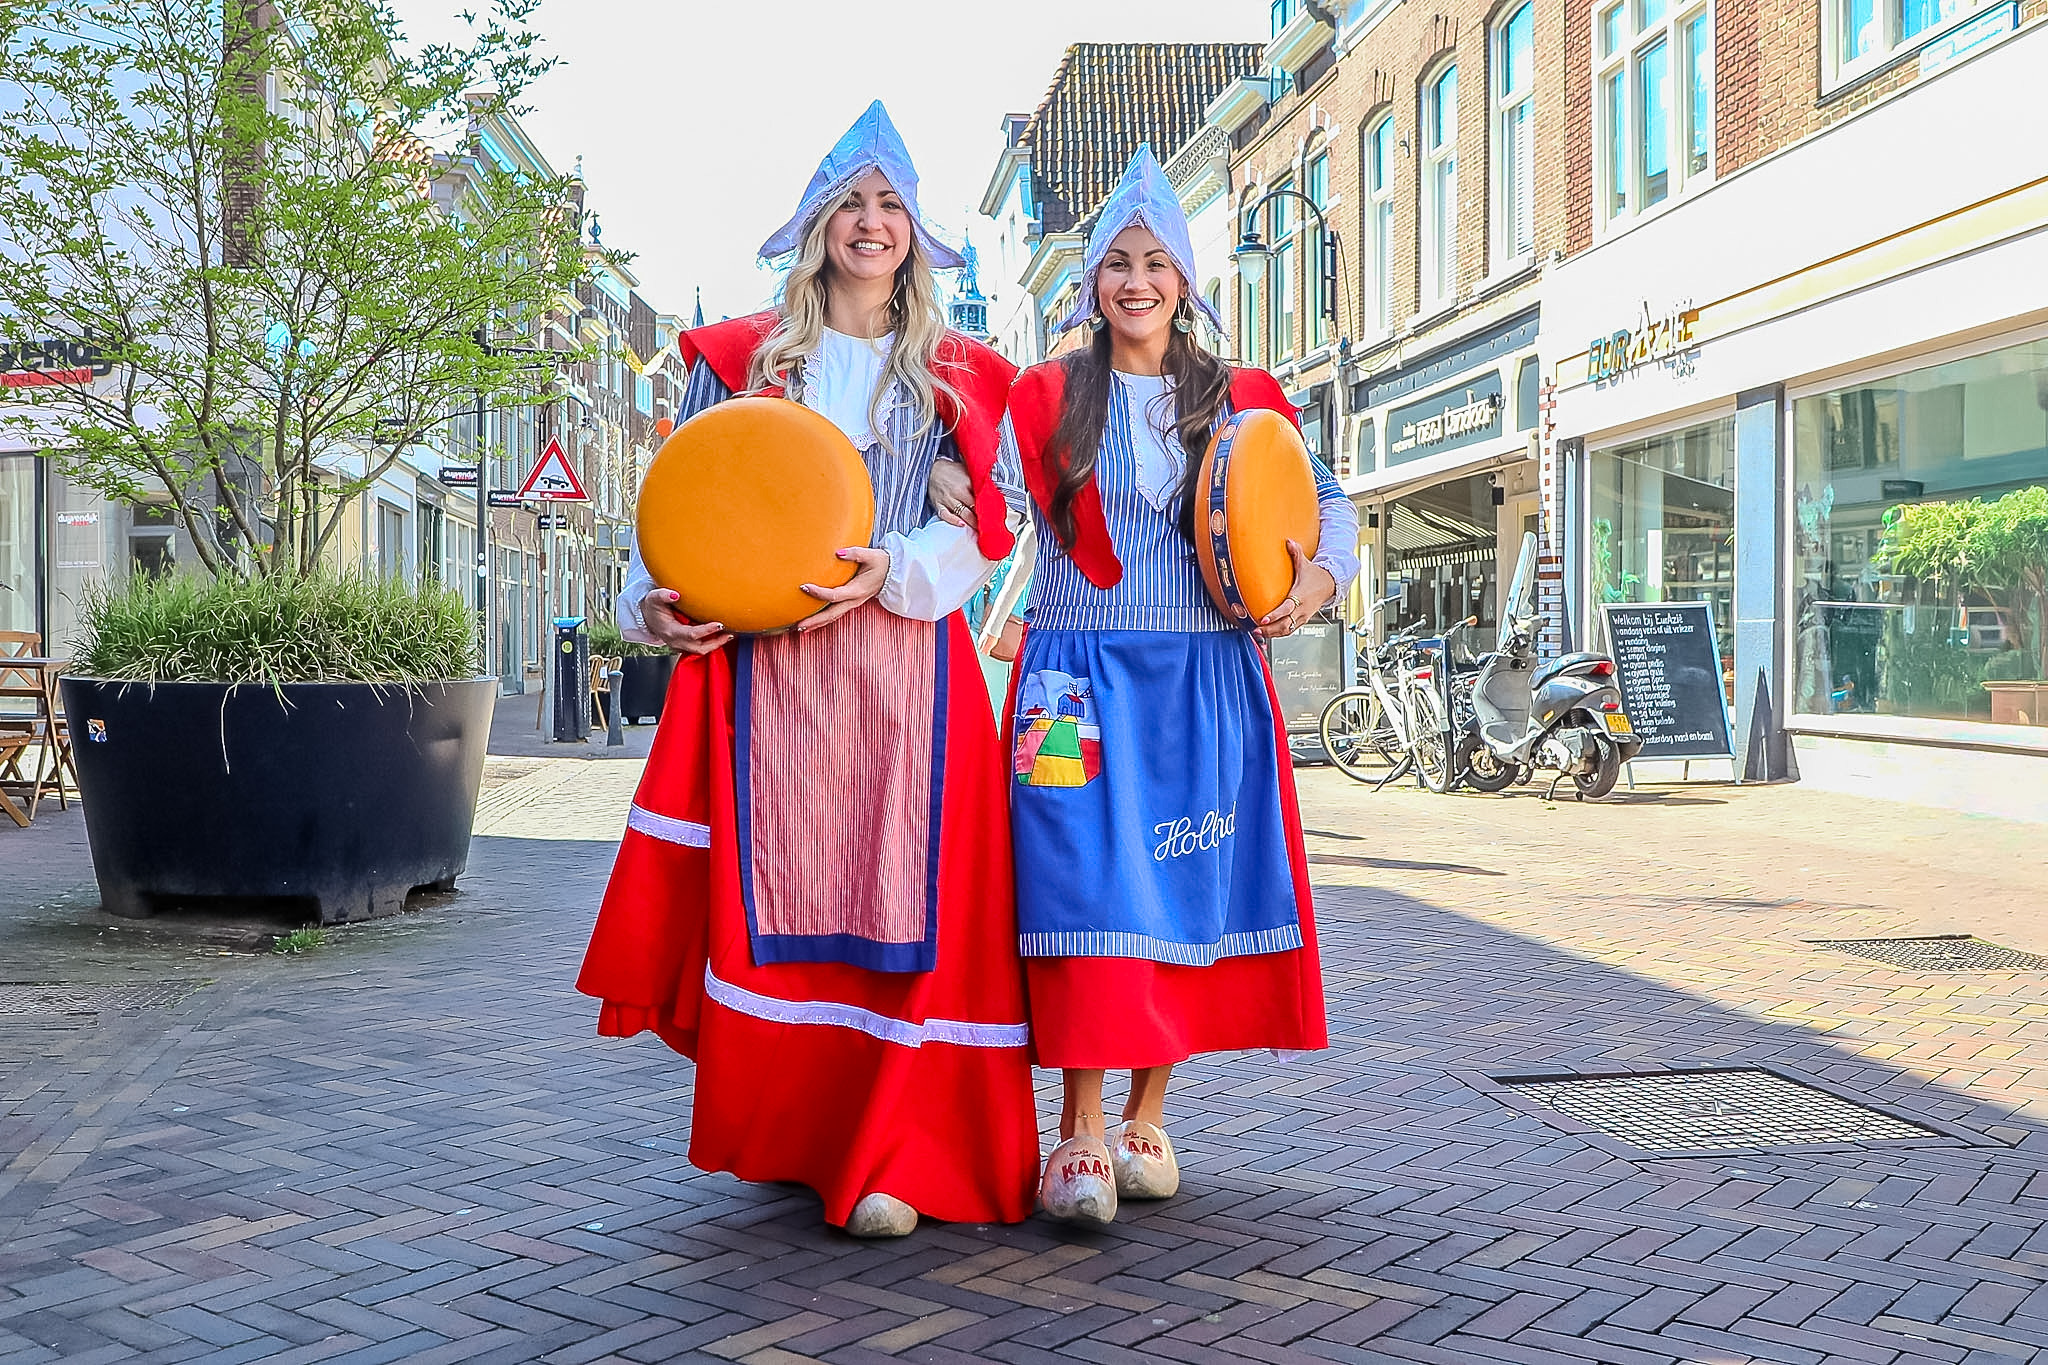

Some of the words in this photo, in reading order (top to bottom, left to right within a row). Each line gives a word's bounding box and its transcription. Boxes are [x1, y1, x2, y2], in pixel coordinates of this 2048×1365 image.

[1612, 613, 1642, 626] Welkom
[1643, 613, 1653, 627] bij
[1126, 1140, 1163, 1160] AAS
